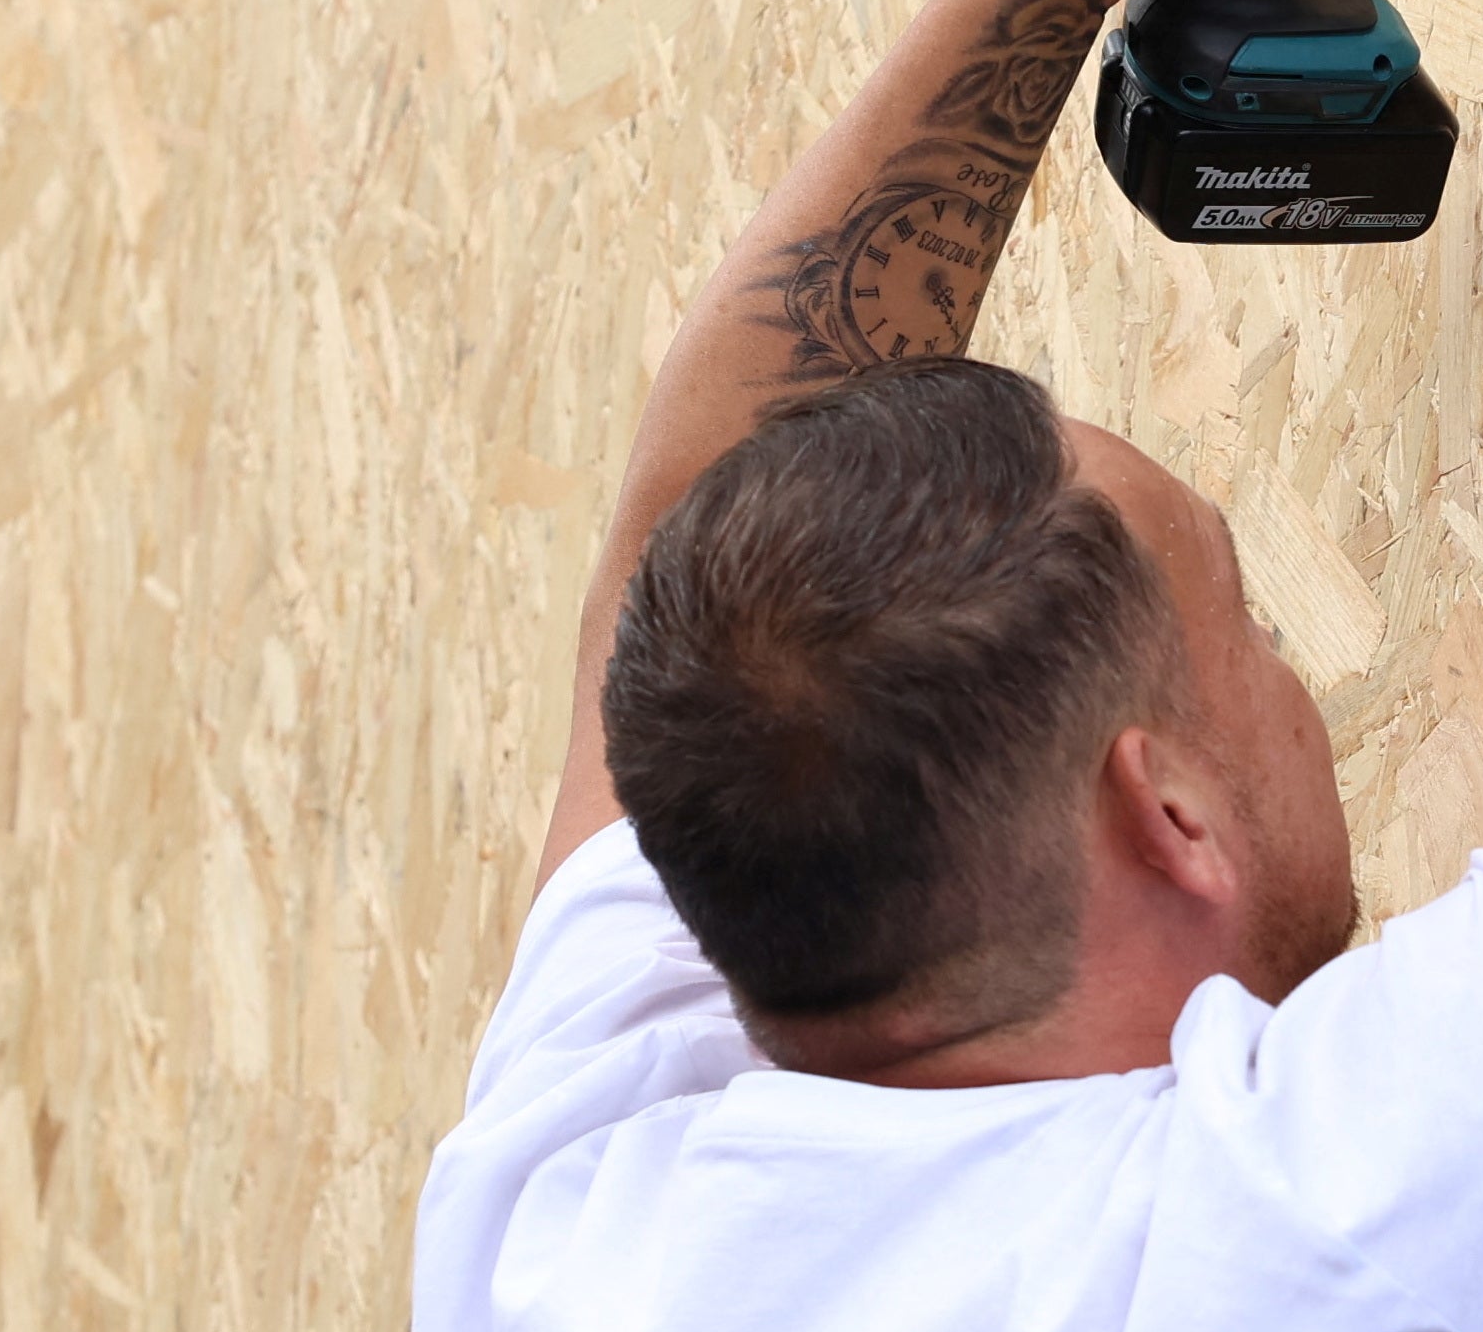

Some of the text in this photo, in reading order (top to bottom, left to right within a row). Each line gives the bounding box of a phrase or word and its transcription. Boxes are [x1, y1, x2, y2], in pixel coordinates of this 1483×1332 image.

[957, 163, 1027, 212] Rose
[1195, 166, 1311, 189] Makita
[1200, 197, 1427, 229] 5.0Ah 18V LITHIUM-ION
